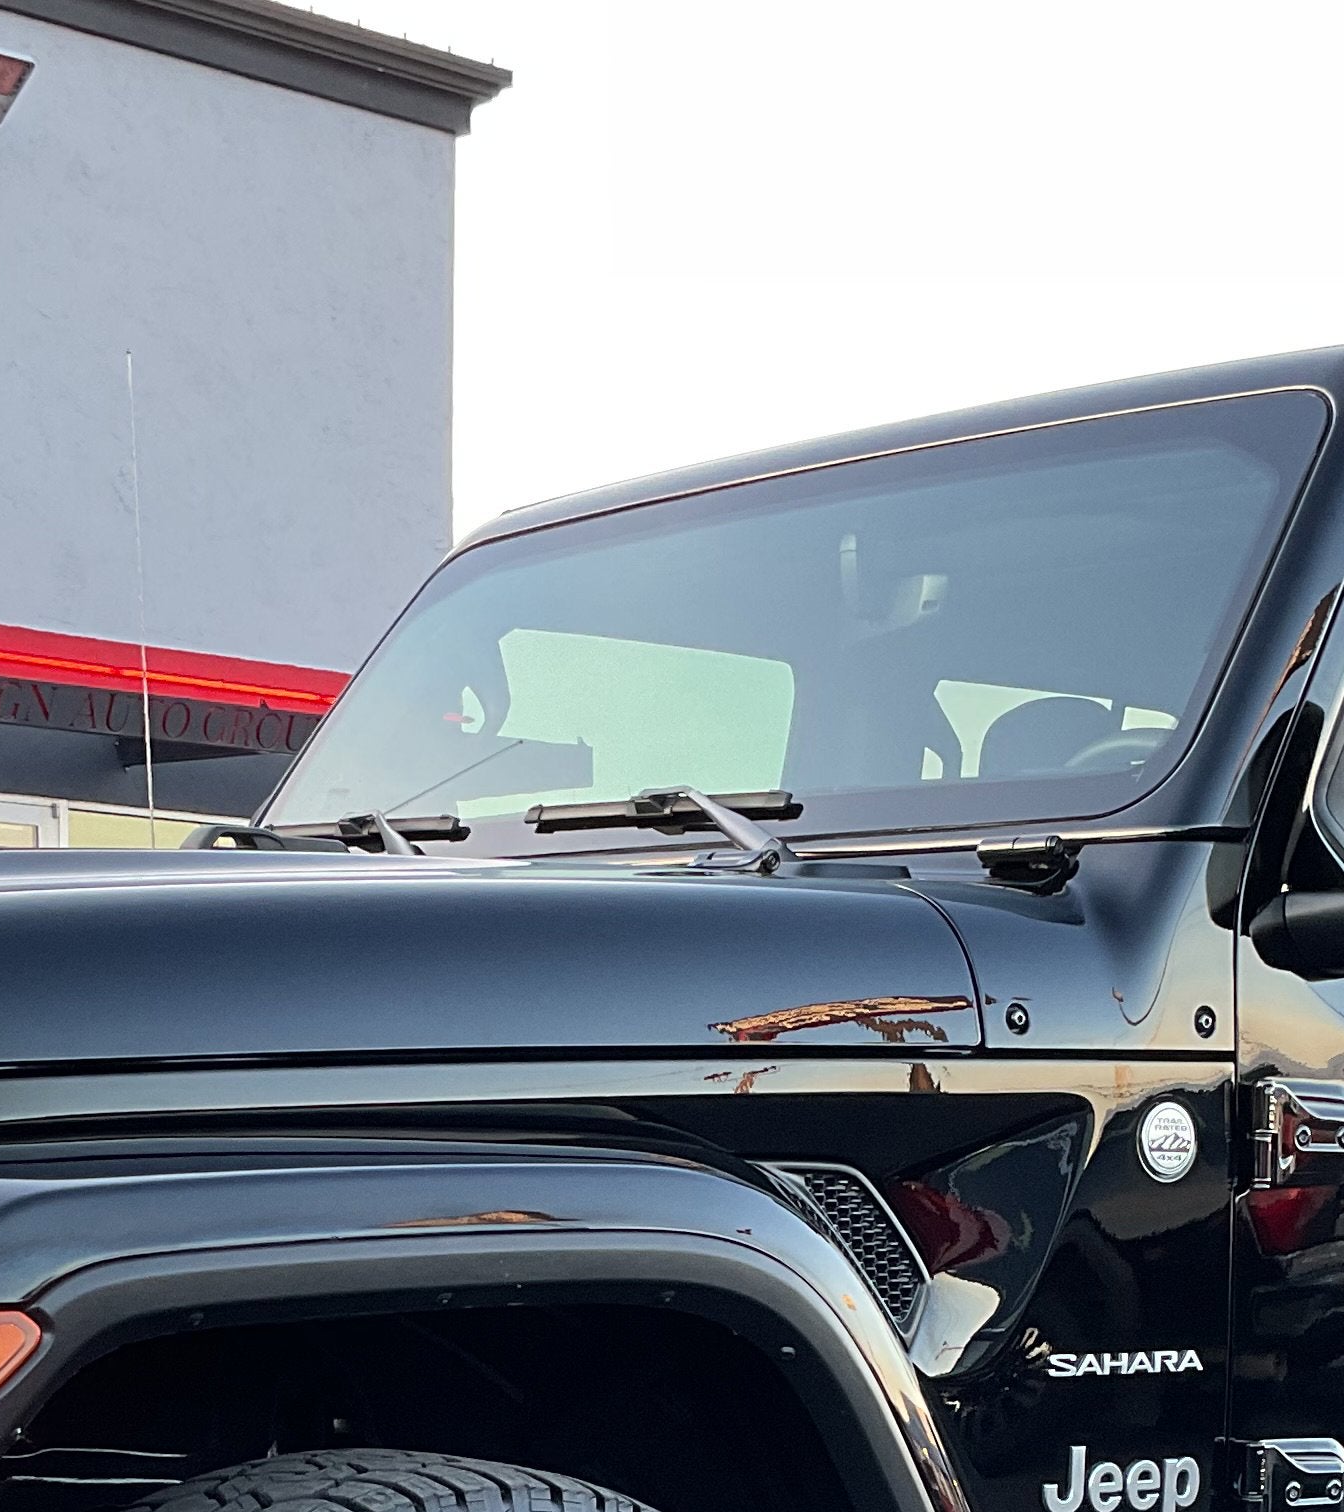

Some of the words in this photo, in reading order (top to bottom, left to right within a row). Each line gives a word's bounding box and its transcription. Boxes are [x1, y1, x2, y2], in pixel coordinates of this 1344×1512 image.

[69, 690, 192, 740] AUTO
[1154, 1124, 1188, 1132] RATED
[1048, 1350, 1204, 1378] SAHARA
